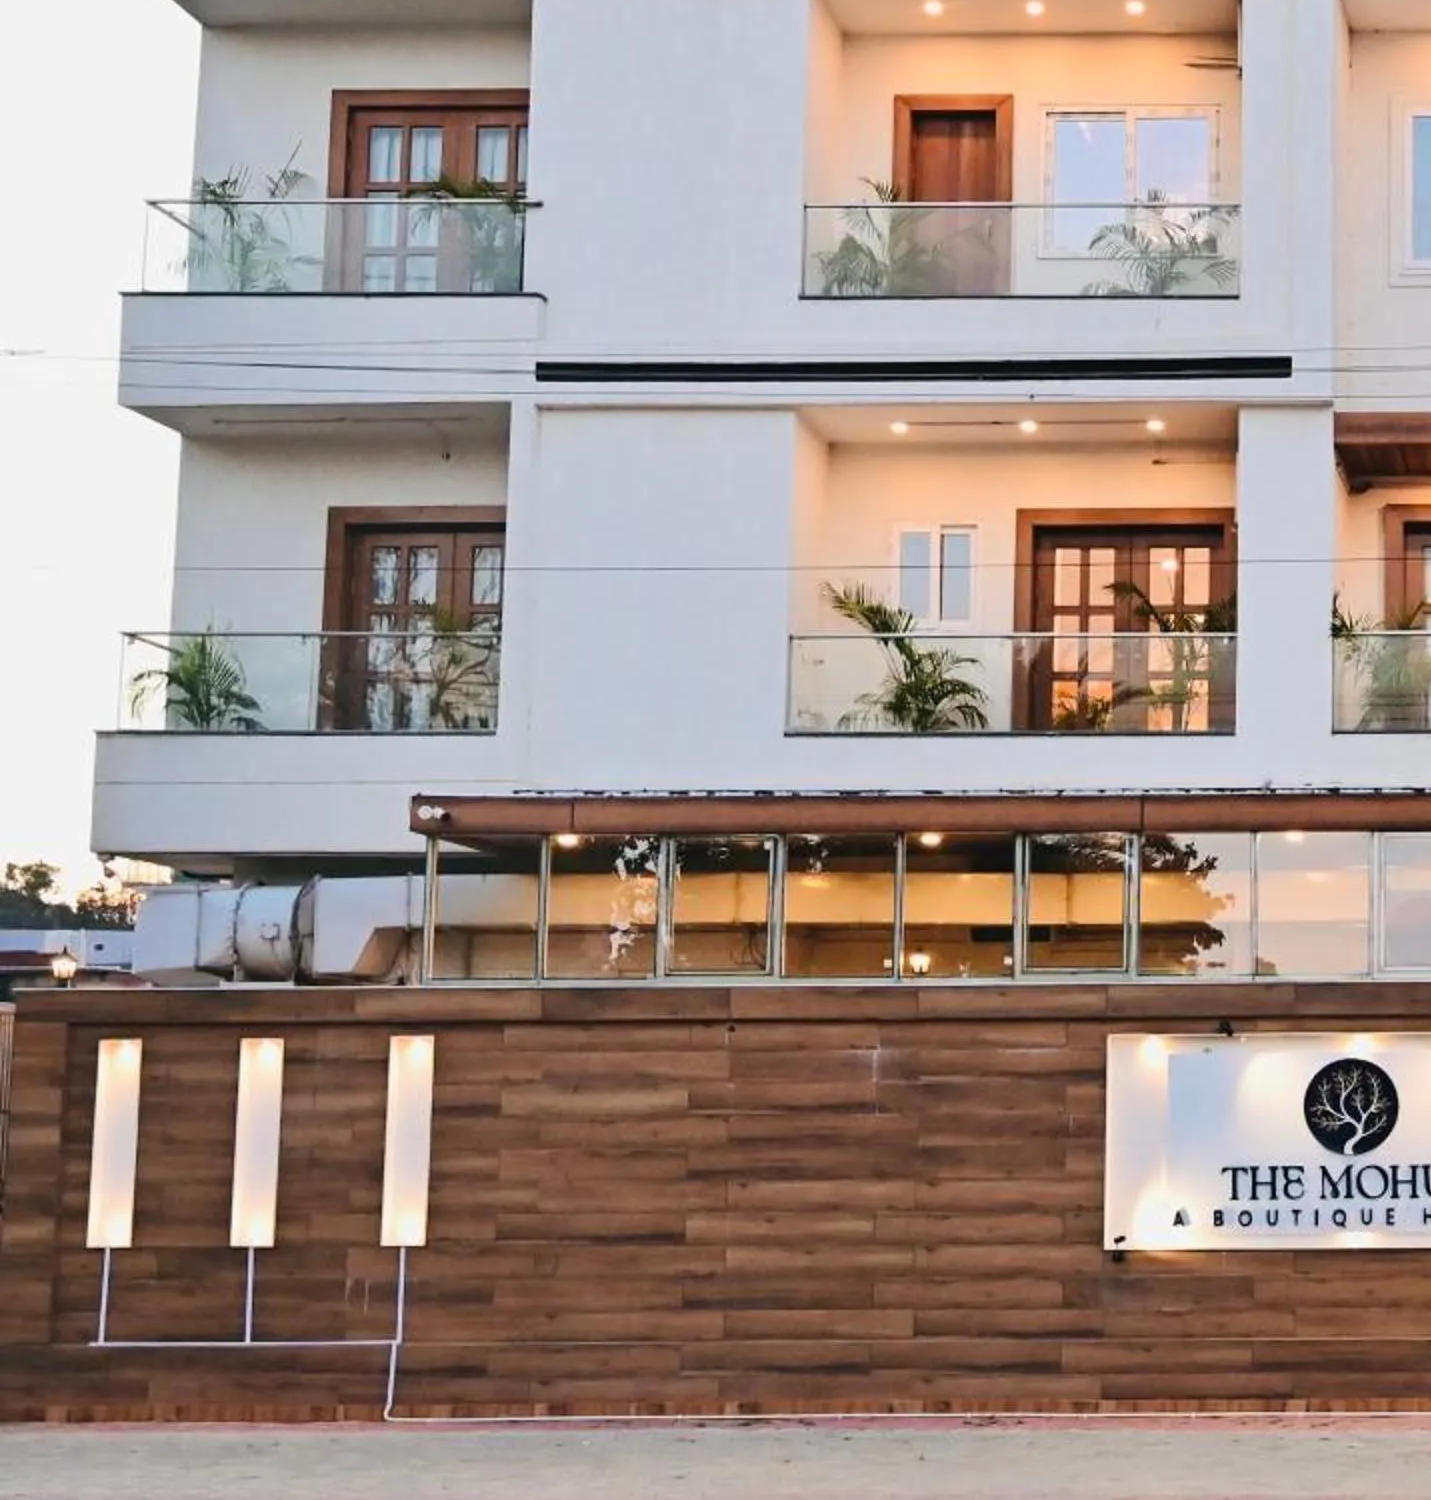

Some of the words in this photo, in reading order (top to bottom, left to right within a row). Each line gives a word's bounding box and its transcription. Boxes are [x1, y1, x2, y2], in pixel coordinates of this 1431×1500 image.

[1221, 1165, 1305, 1201] THE
[1172, 1209, 1187, 1227] A
[1213, 1207, 1396, 1229] BOUTIQUE
